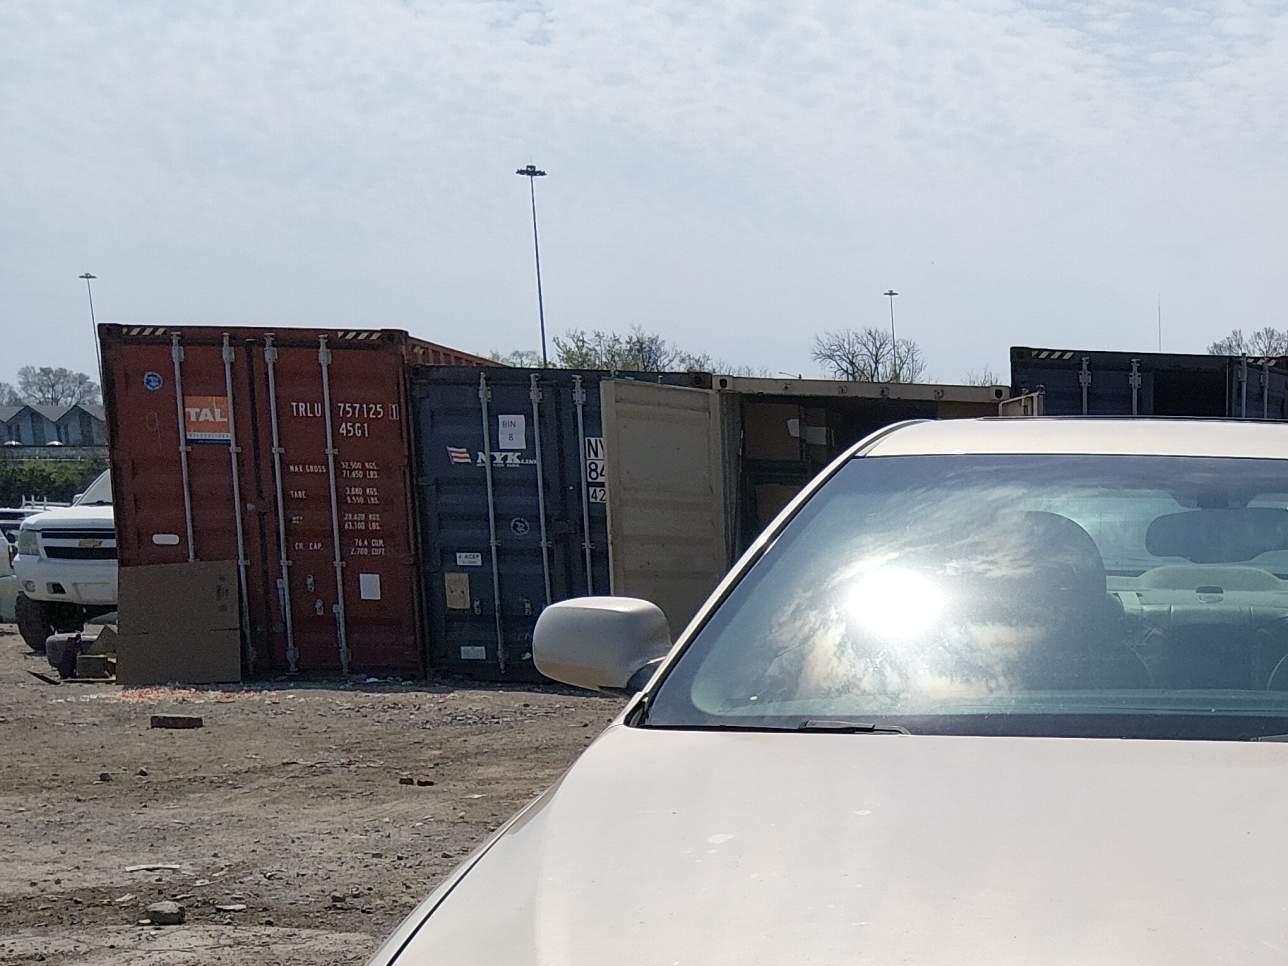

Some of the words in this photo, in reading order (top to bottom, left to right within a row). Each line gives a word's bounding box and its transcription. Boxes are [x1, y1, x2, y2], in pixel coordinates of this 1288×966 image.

[185, 408, 228, 422] TAL
[291, 402, 322, 417] TRLU
[338, 403, 384, 419] 757125
[339, 422, 369, 438] 45G1
[477, 451, 521, 464] NYK
[591, 488, 606, 501] 42
